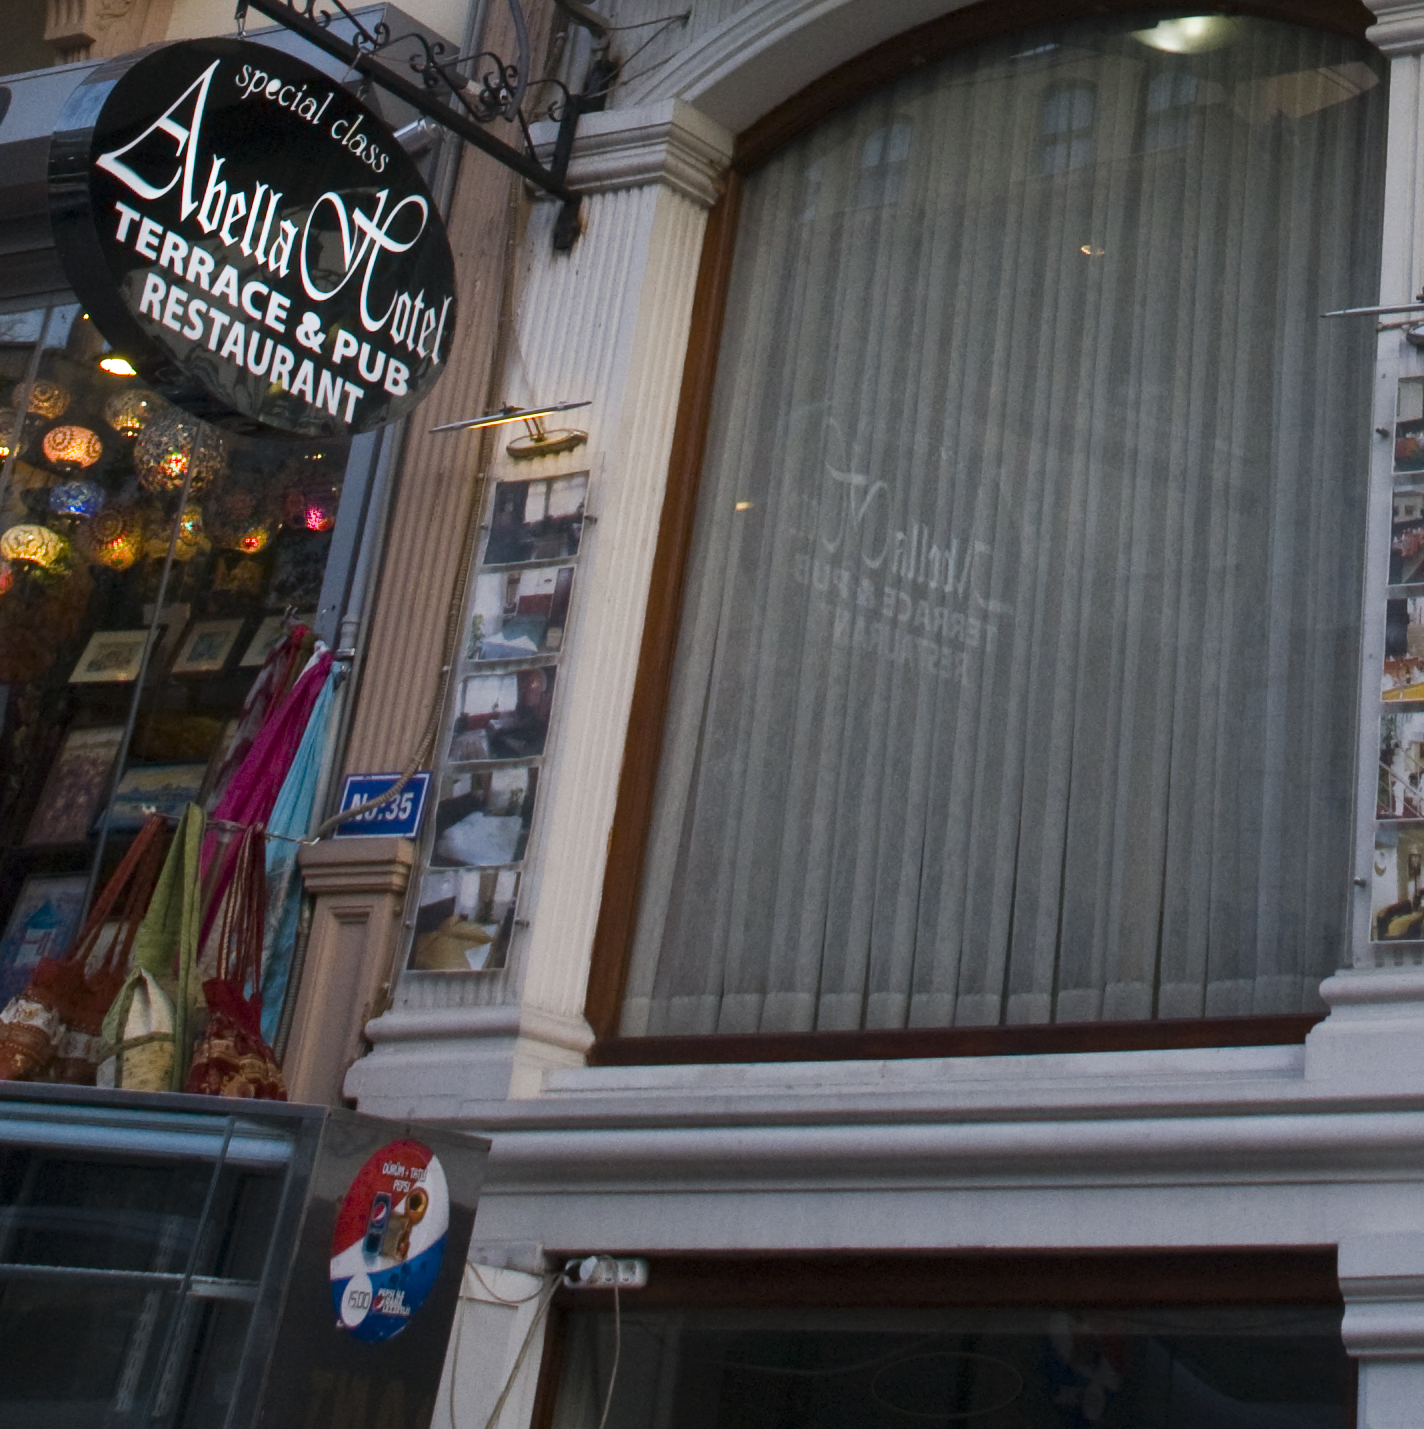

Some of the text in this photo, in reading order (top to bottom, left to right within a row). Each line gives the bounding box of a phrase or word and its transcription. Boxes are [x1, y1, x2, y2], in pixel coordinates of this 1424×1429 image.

[235, 63, 390, 173] special class
[95, 59, 453, 366] Abella Hotel
[114, 202, 409, 398] TERRACE & PUB
[140, 273, 365, 423] RESTAURANT
